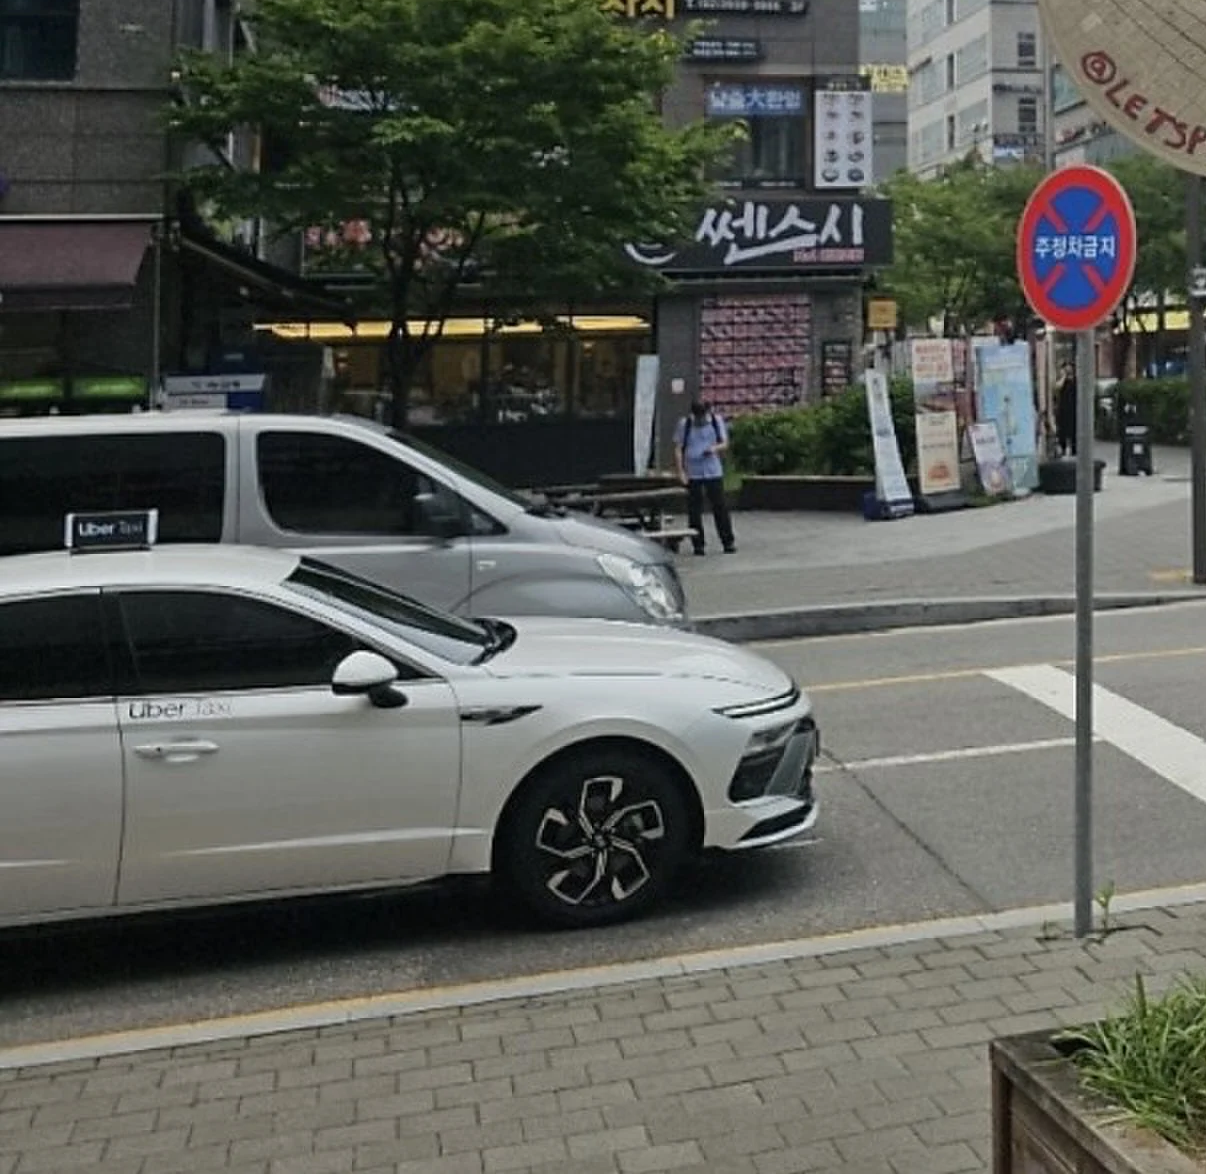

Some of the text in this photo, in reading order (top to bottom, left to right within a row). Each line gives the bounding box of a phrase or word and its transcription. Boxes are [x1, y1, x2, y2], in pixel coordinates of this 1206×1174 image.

[1035, 234, 1116, 258] 주정차금지
[79, 522, 114, 536] Uber
[128, 702, 184, 720] Uber
